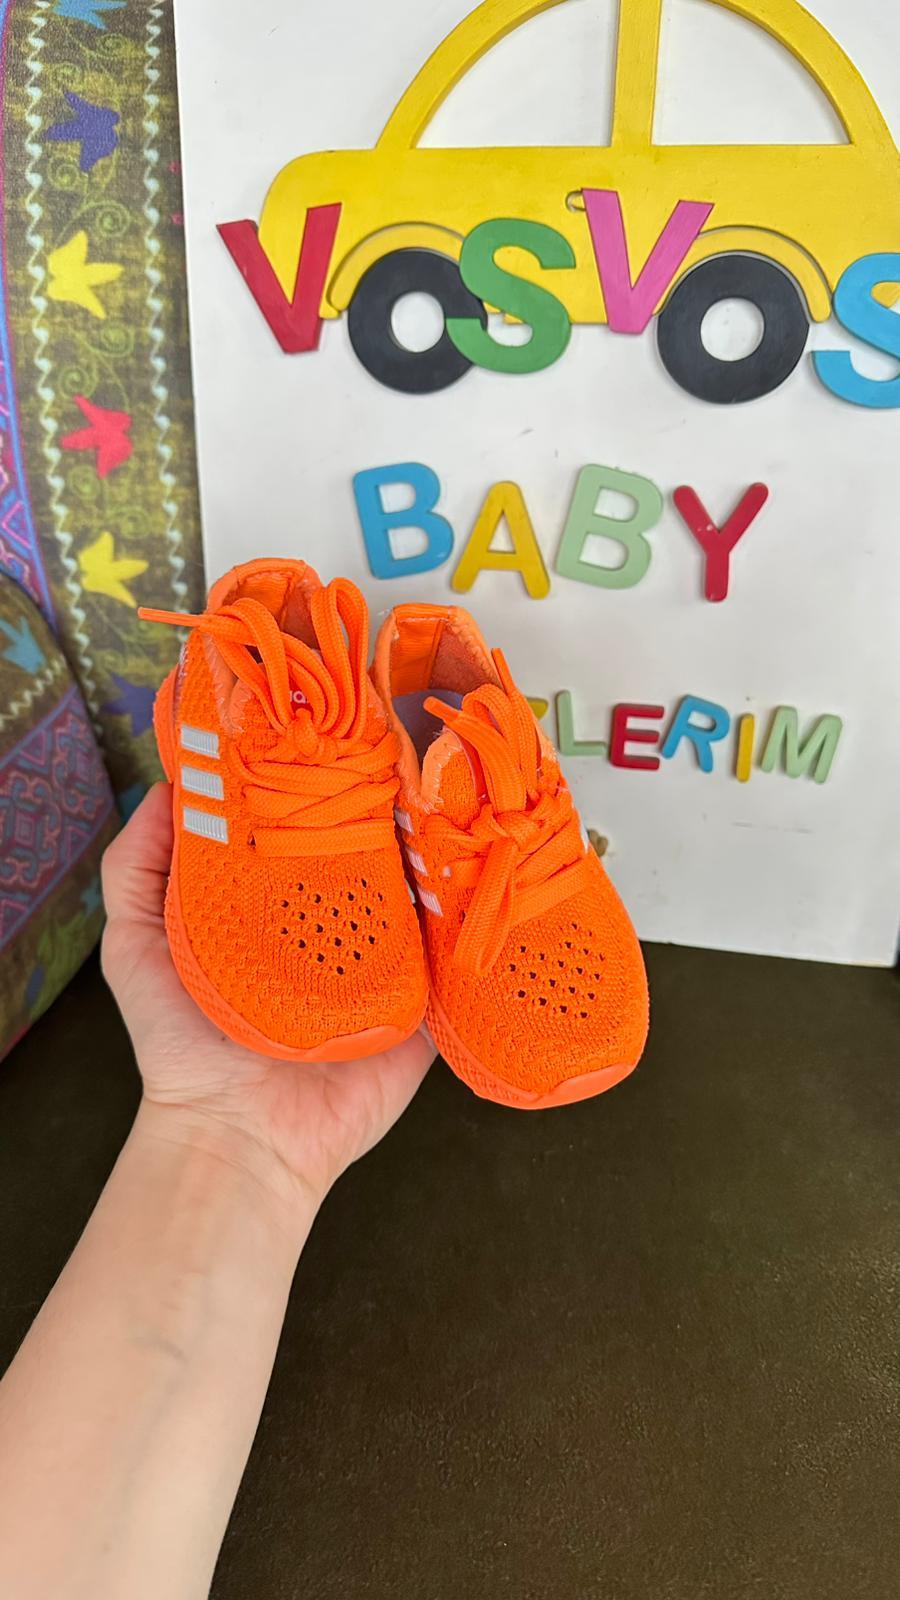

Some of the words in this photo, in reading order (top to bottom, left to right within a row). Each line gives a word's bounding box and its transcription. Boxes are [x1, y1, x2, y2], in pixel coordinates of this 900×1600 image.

[216, 188, 900, 409] VOSVOS
[352, 462, 769, 602] BABY
[528, 689, 843, 785] LERIM
